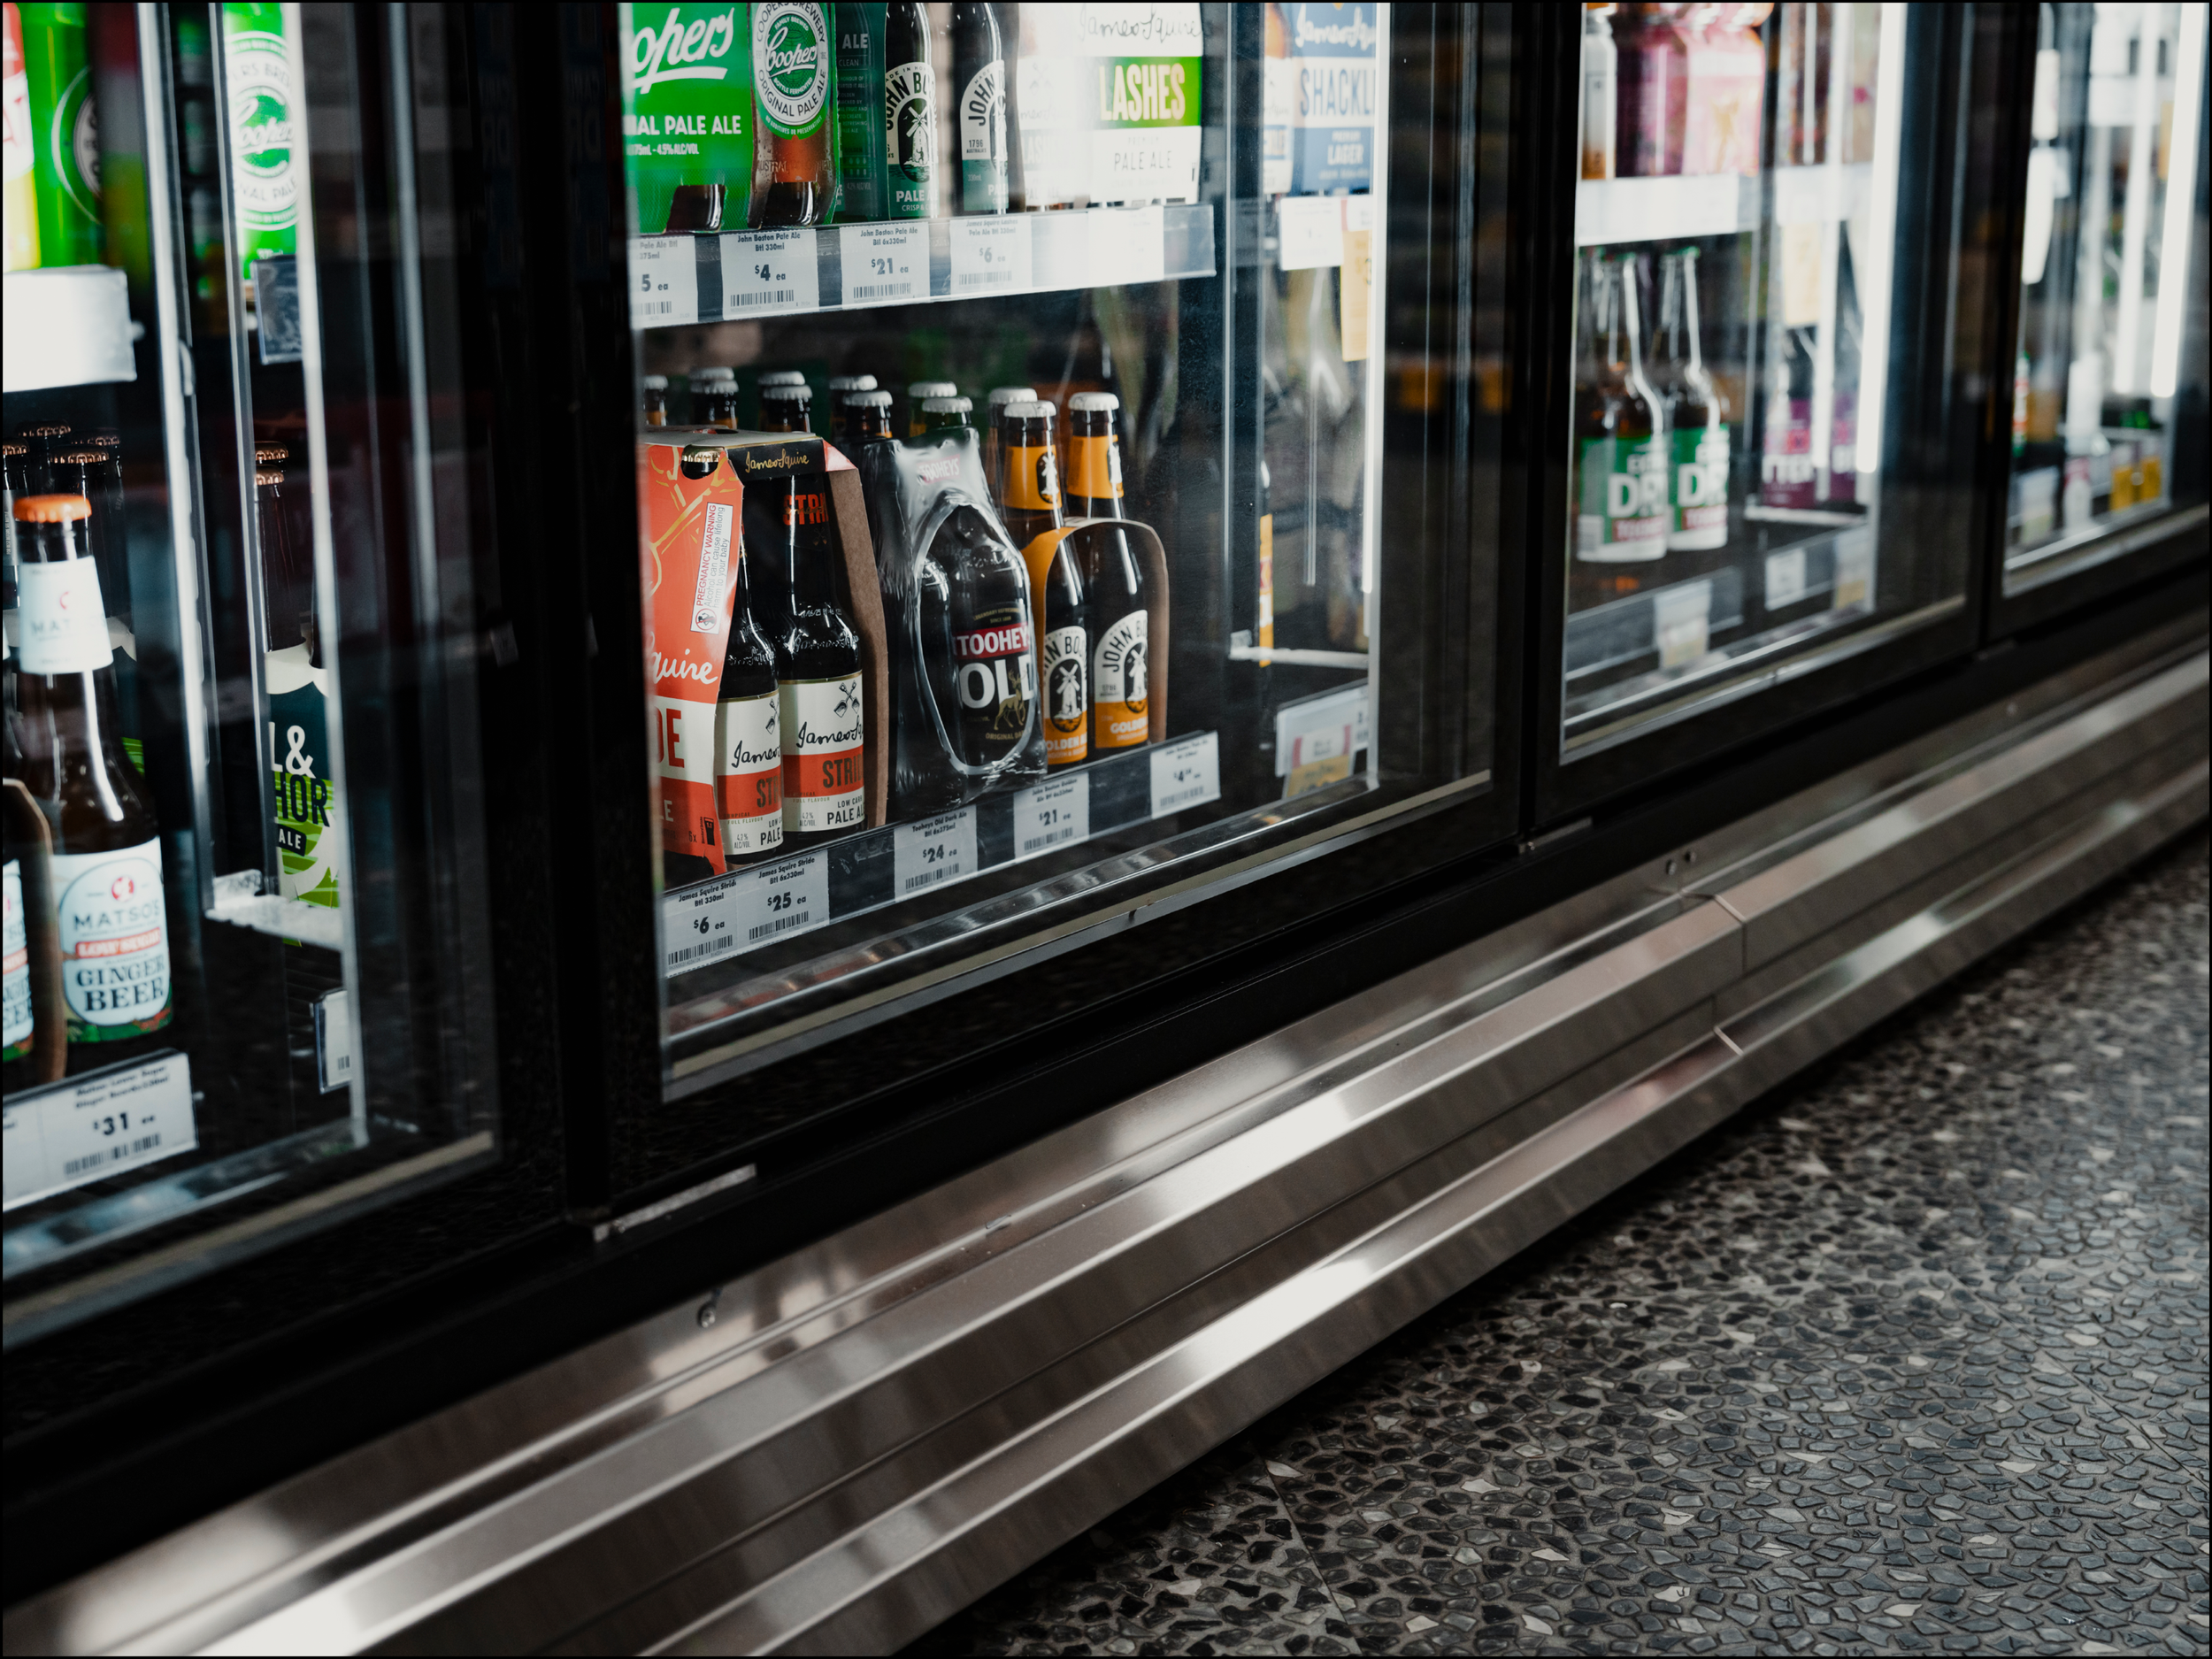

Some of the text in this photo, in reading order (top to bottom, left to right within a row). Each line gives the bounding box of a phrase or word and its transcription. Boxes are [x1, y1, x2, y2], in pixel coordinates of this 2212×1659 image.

[632, 7, 734, 94] opers
[765, 27, 817, 75] Coopers
[841, 33, 868, 50] ALE
[838, 58, 859, 67] CLEAN
[758, 69, 827, 117] ORIGINAL PALE ALE
[1099, 63, 1187, 121] LASHES
[664, 115, 741, 135] PALE ALE
[968, 139, 984, 148] 1796
[1114, 150, 1172, 172] PALE ALE
[895, 189, 925, 203] PALE
[737, 234, 752, 243] John
[753, 234, 775, 243] Boston
[775, 233, 789, 242] Pale
[860, 228, 874, 237] John
[875, 227, 895, 236] Boston
[656, 240, 667, 250] Ale
[755, 242, 785, 252] Btl 330ml
[979, 247, 993, 264] $6
[754, 264, 787, 281] $4 ea
[871, 257, 894, 275] $21
[657, 282, 669, 291] ea
[714, 506, 726, 535] lifelong
[695, 504, 717, 606] PREGNANCY WARNING
[712, 536, 721, 561] cause
[711, 537, 730, 609] harm to your baby
[703, 578, 716, 608] Alcohol
[1102, 626, 1133, 672] JOHN
[652, 648, 718, 685] quire
[285, 725, 317, 780] &
[1044, 736, 1079, 751] OLDEN
[274, 772, 331, 827] HOR
[837, 798, 851, 809] LOW
[768, 819, 779, 828] LOW
[826, 807, 855, 825] PALE
[912, 821, 934, 832] Tooheys
[944, 813, 957, 823] Dark
[1039, 809, 1057, 826] $21
[279, 828, 302, 850] ALE
[687, 830, 698, 843] 6x
[760, 826, 781, 846] PALE
[922, 843, 945, 864] $24
[758, 856, 816, 879] James Squire Stride
[769, 867, 805, 885] Btl 6x330ml
[679, 892, 698, 902] James
[699, 885, 719, 896] Squire
[695, 892, 725, 907] Btl 330ml
[767, 891, 807, 912] $25 ea
[73, 897, 160, 932] MATSO'S
[693, 916, 725, 934] $6 ea
[76, 954, 165, 987] GINGER
[85, 975, 165, 1012] BEER
